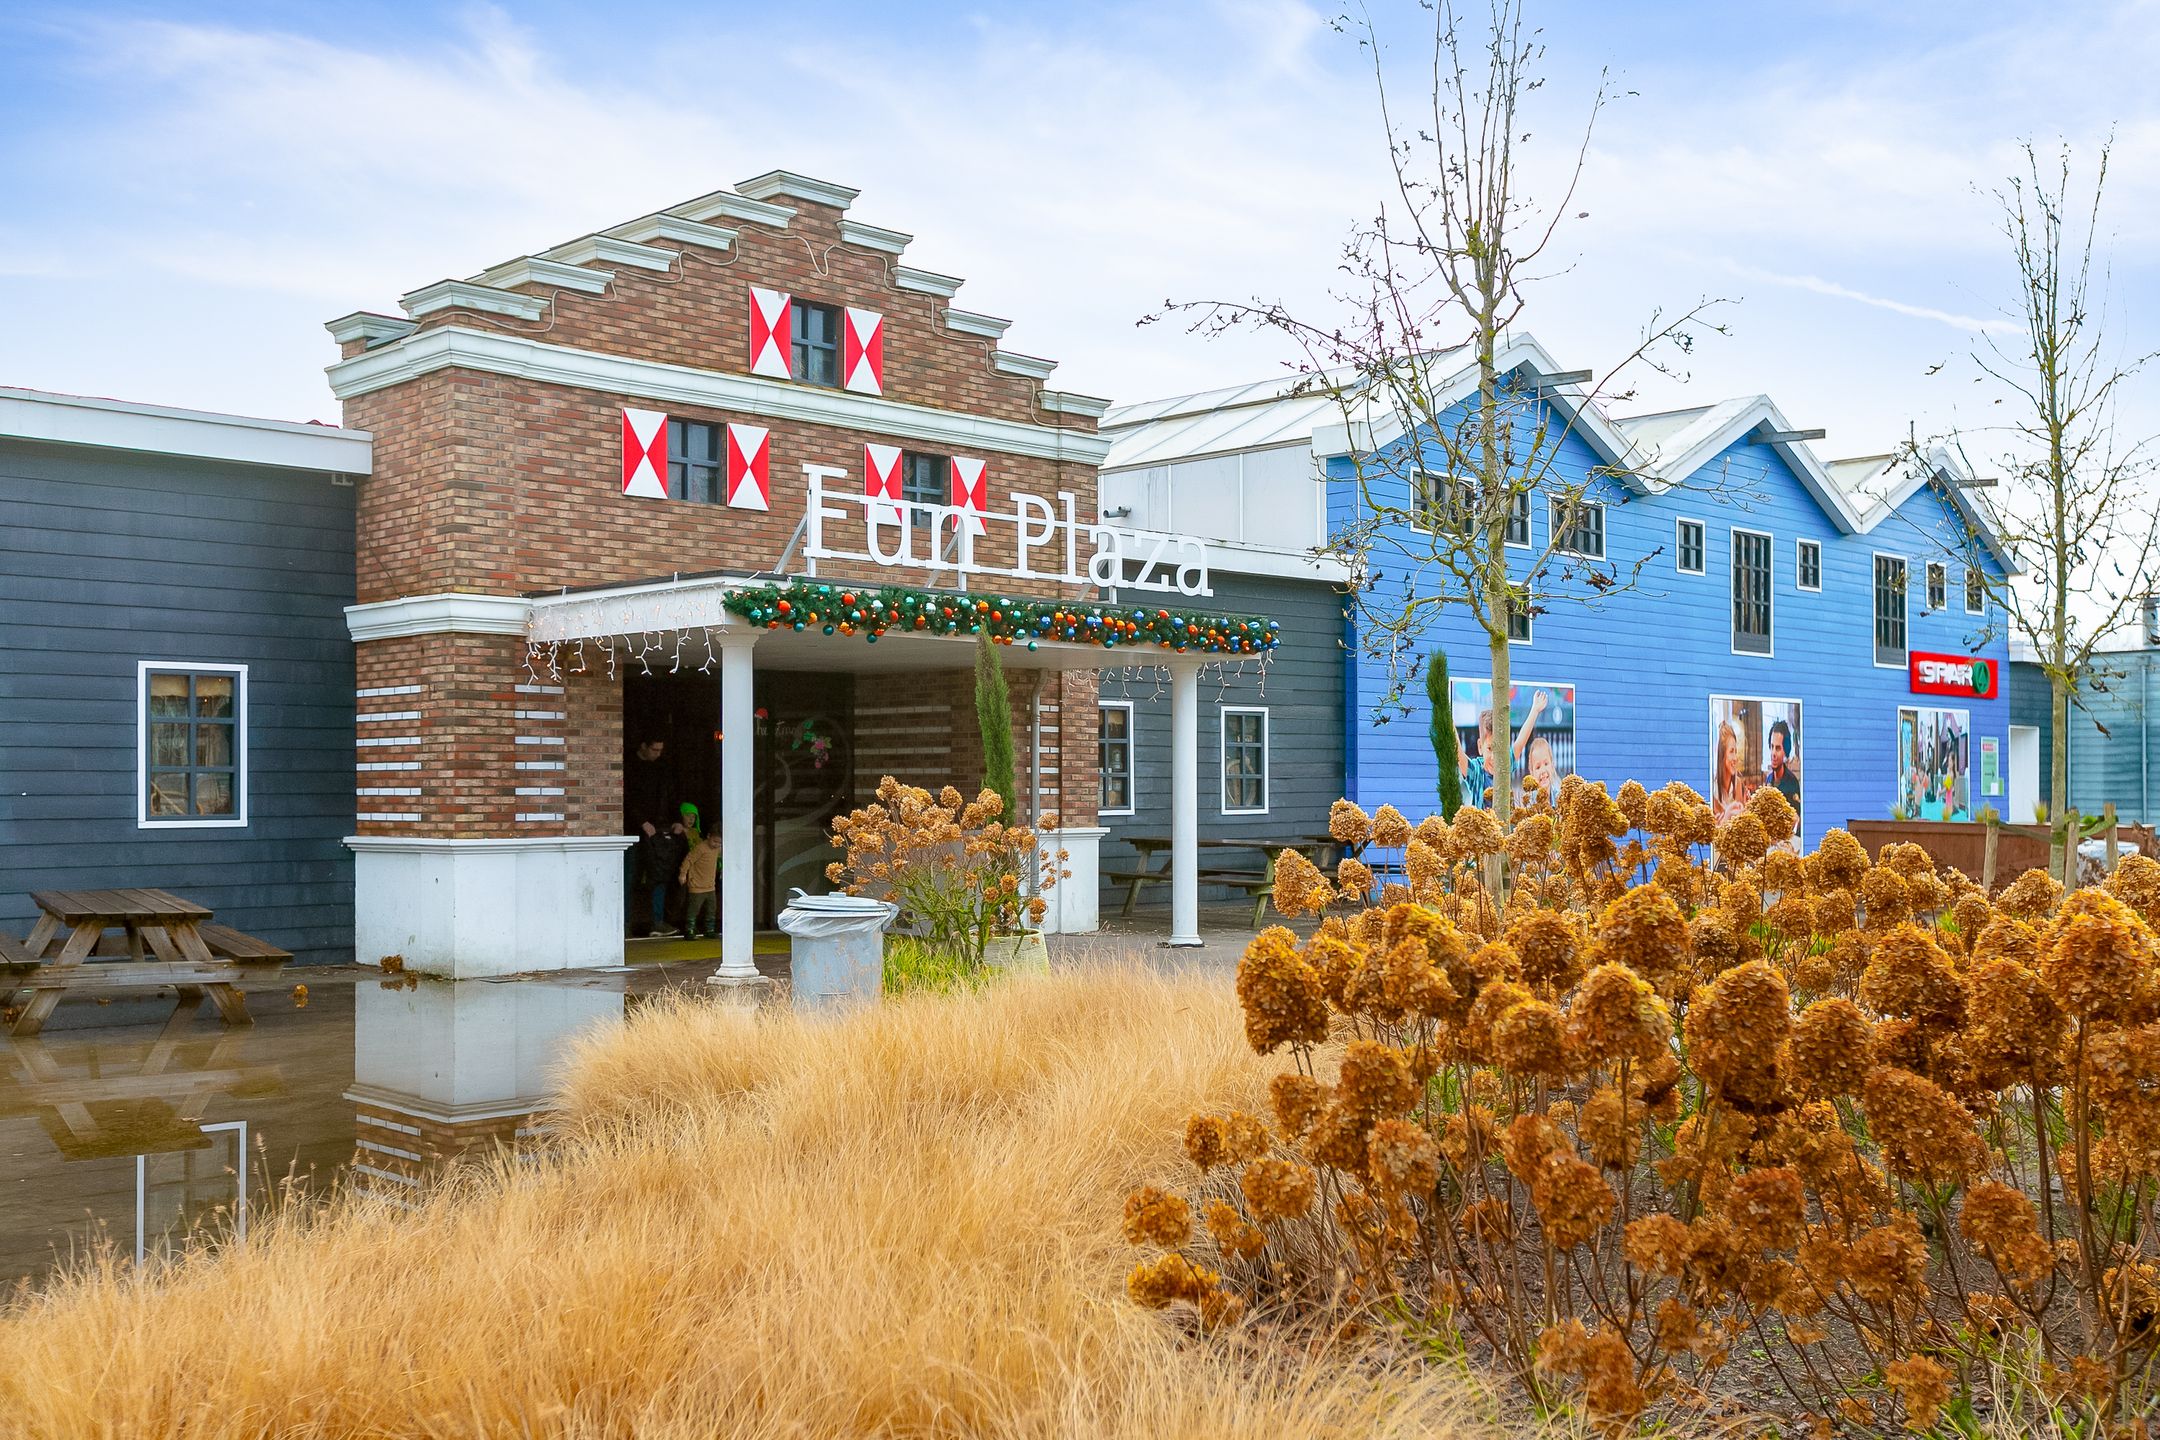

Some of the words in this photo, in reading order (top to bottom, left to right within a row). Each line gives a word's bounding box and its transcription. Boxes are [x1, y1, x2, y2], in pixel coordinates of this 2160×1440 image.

[802, 463, 980, 573] Fun
[1010, 491, 1214, 597] Plaza
[1919, 660, 1973, 687] SPAR
